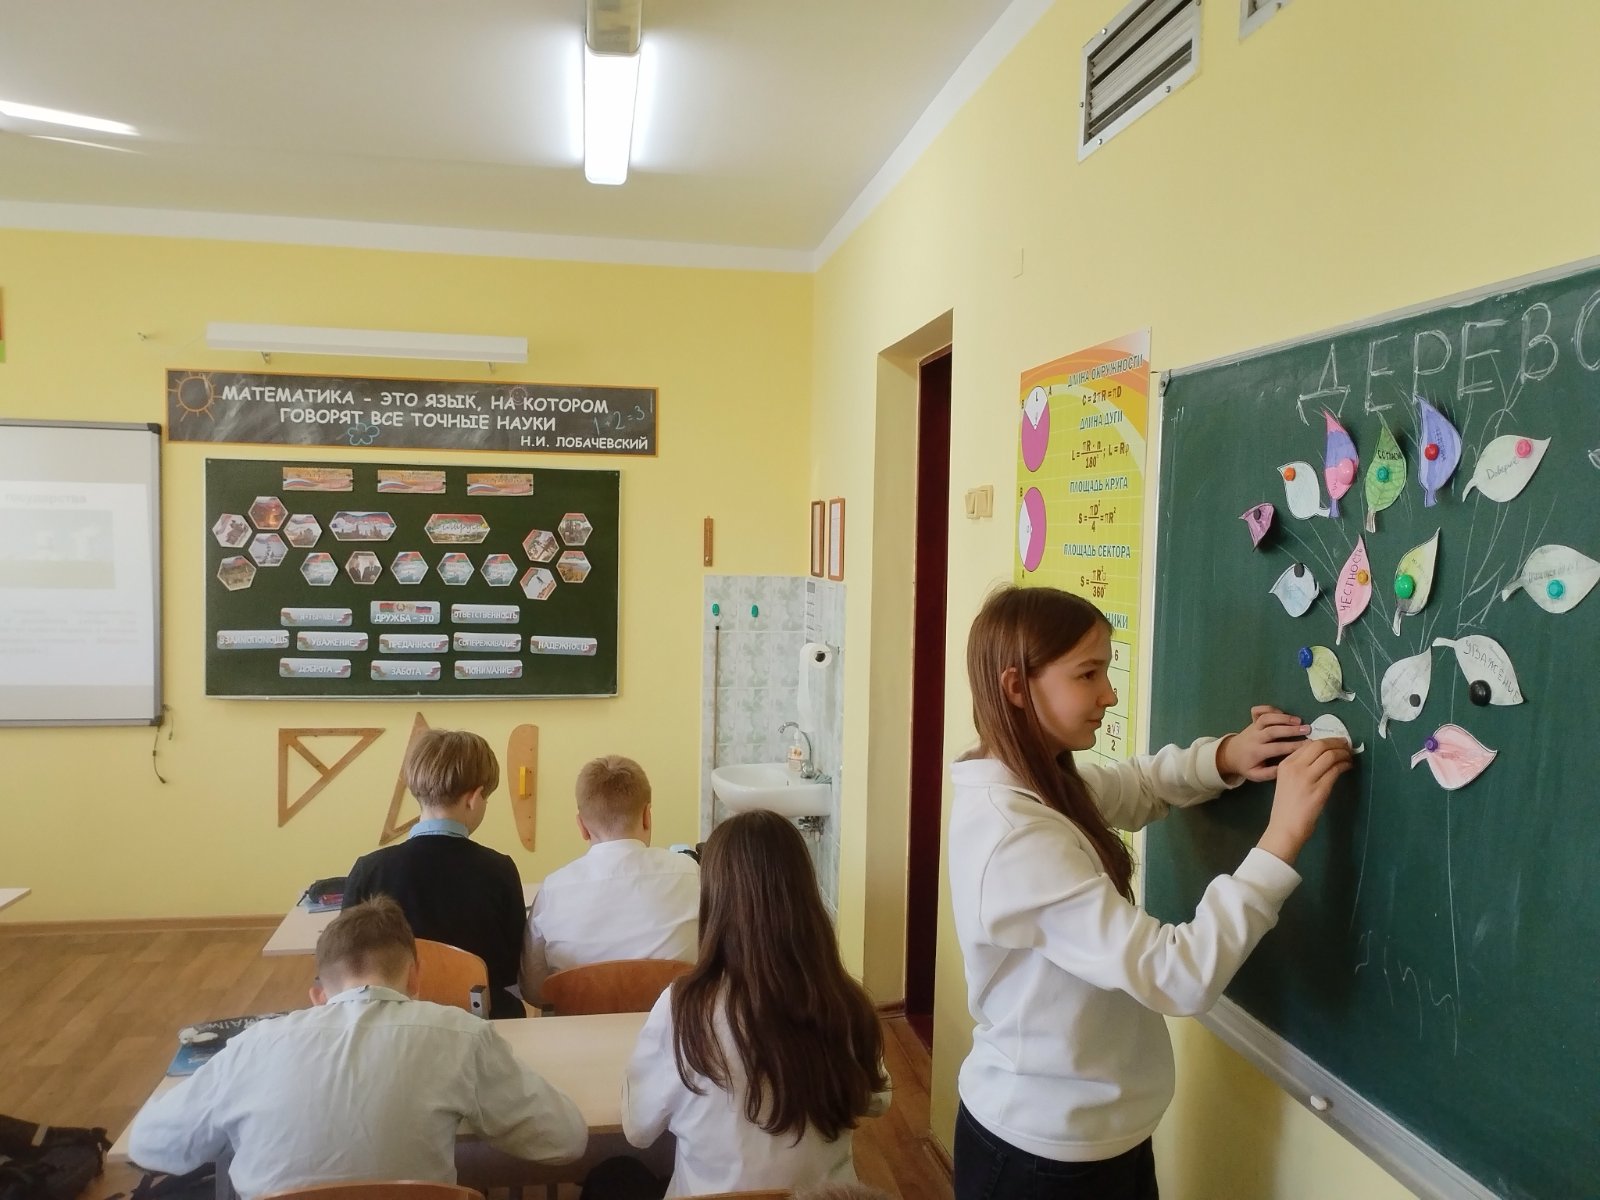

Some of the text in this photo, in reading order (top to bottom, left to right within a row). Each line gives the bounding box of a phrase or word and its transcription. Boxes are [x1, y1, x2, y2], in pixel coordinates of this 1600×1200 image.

[1067, 353, 1143, 388] ДЛИНА ОКРУЖНОСТИ
[221, 385, 355, 404] МАТЕМАТИКА
[380, 393, 419, 407] ЭТО
[425, 394, 482, 412] ЯЗЫК,
[490, 395, 517, 411] НА
[523, 397, 609, 414] КОТОРОМ
[279, 408, 557, 432] ГОВОРЯТ ВСЕ ТОЧНЫЕ НАУКИ
[1080, 410, 1123, 430] ДЛИНА ДУГИ
[520, 436, 649, 450] Н.И. ЛОБАЧЕВСКИЙ
[1070, 477, 1129, 494] ПЛОЩАДЬ КРУГА
[1064, 544, 1131, 559] ПЛОЩАДЬ СЕКТОРА
[374, 613, 412, 623] ДРУЖБА
[419, 614, 435, 623] ЭТО
[311, 637, 355, 647] УВАЖЕНИЕ
[390, 665, 422, 676] ЗАБОТА
